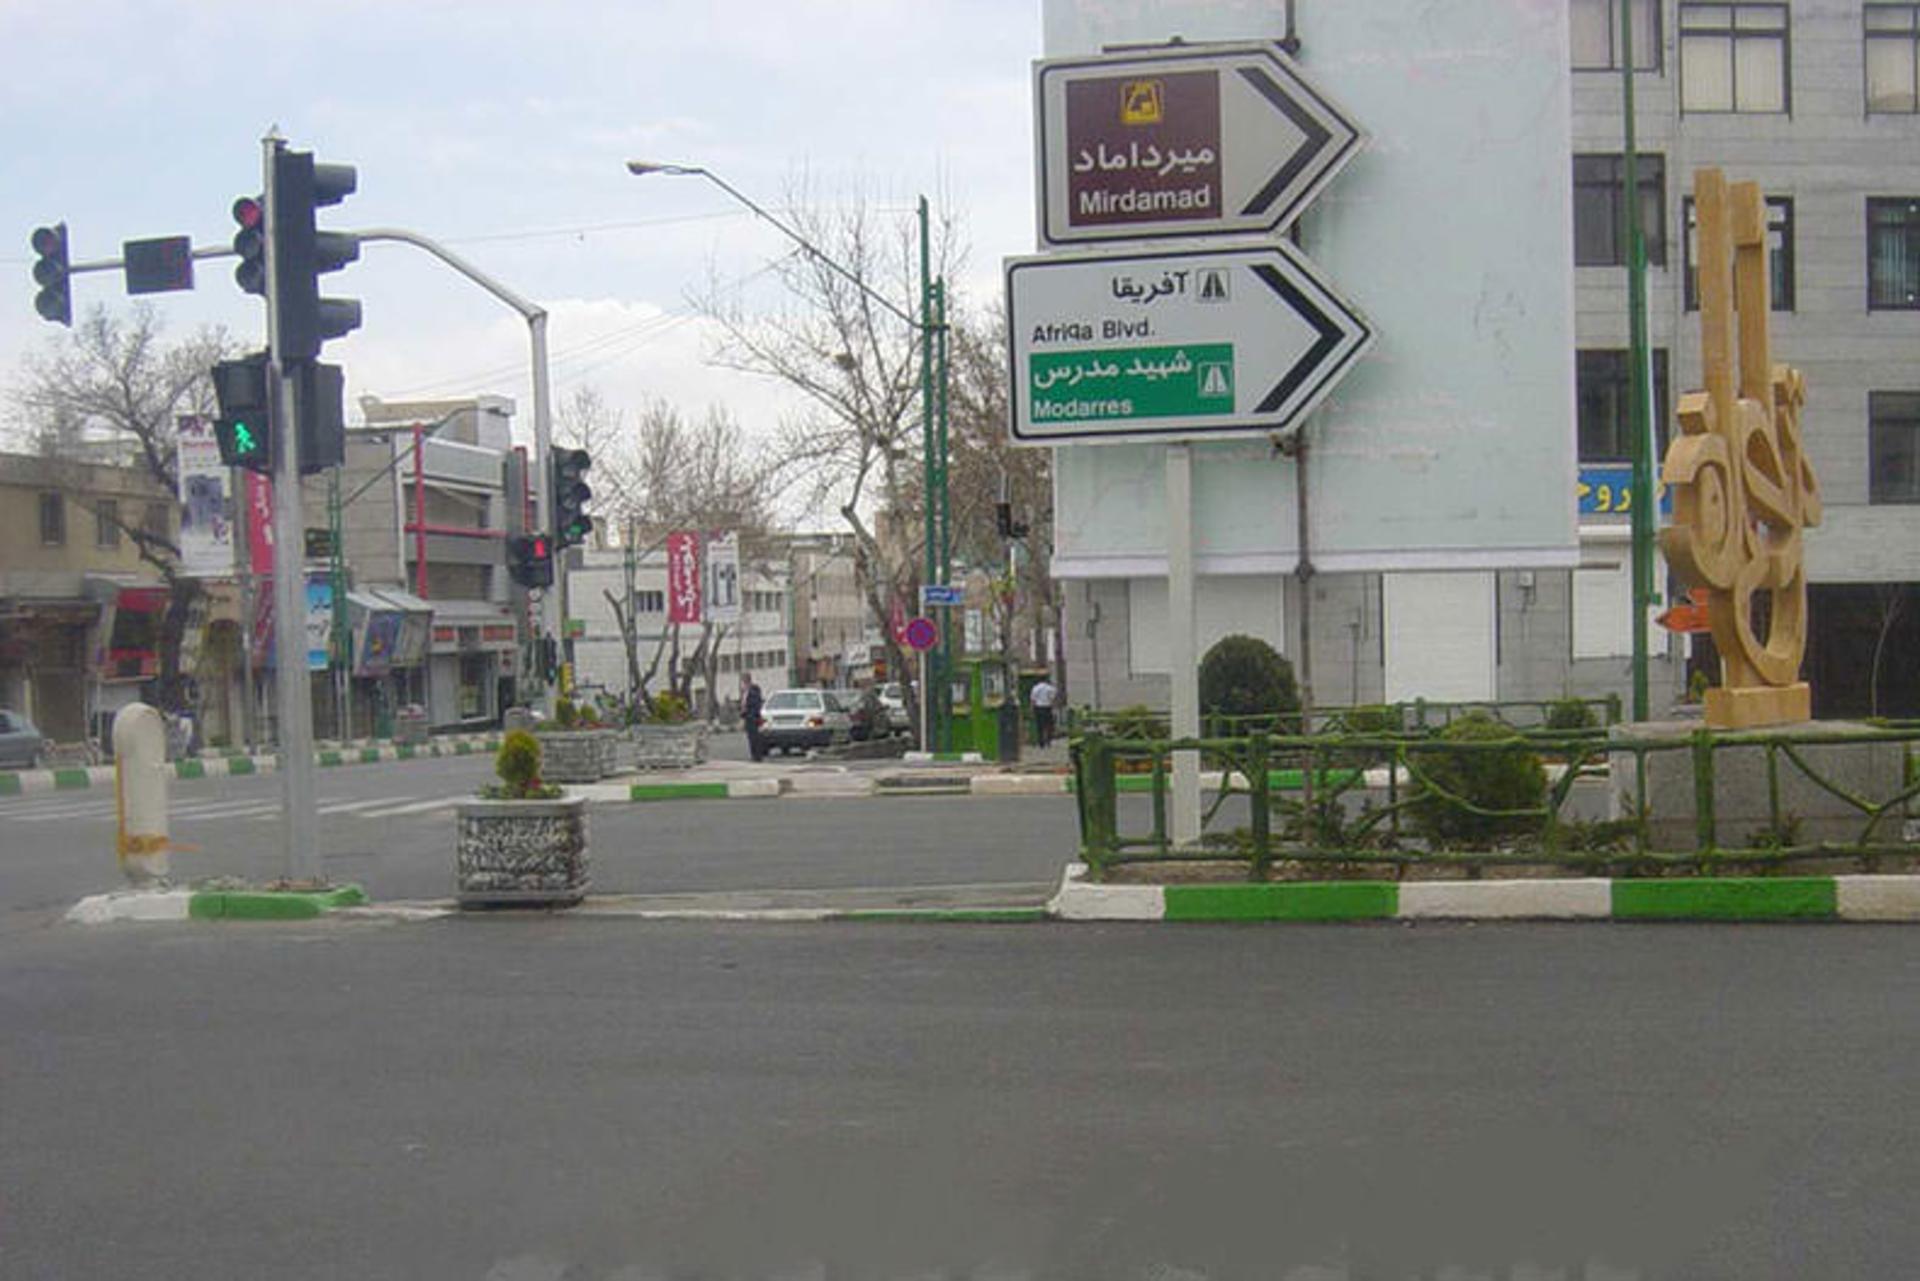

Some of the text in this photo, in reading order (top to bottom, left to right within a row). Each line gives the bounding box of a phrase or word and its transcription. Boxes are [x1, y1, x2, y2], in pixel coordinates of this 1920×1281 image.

[1073, 142, 1215, 176] میرداماد
[1079, 184, 1211, 214] Mirdamad
[1112, 271, 1189, 304] آفریقا
[1032, 317, 1156, 343] Afriqa Blvd.
[1034, 349, 1192, 389] شهید مدرس
[1034, 399, 1133, 419] Modarres
